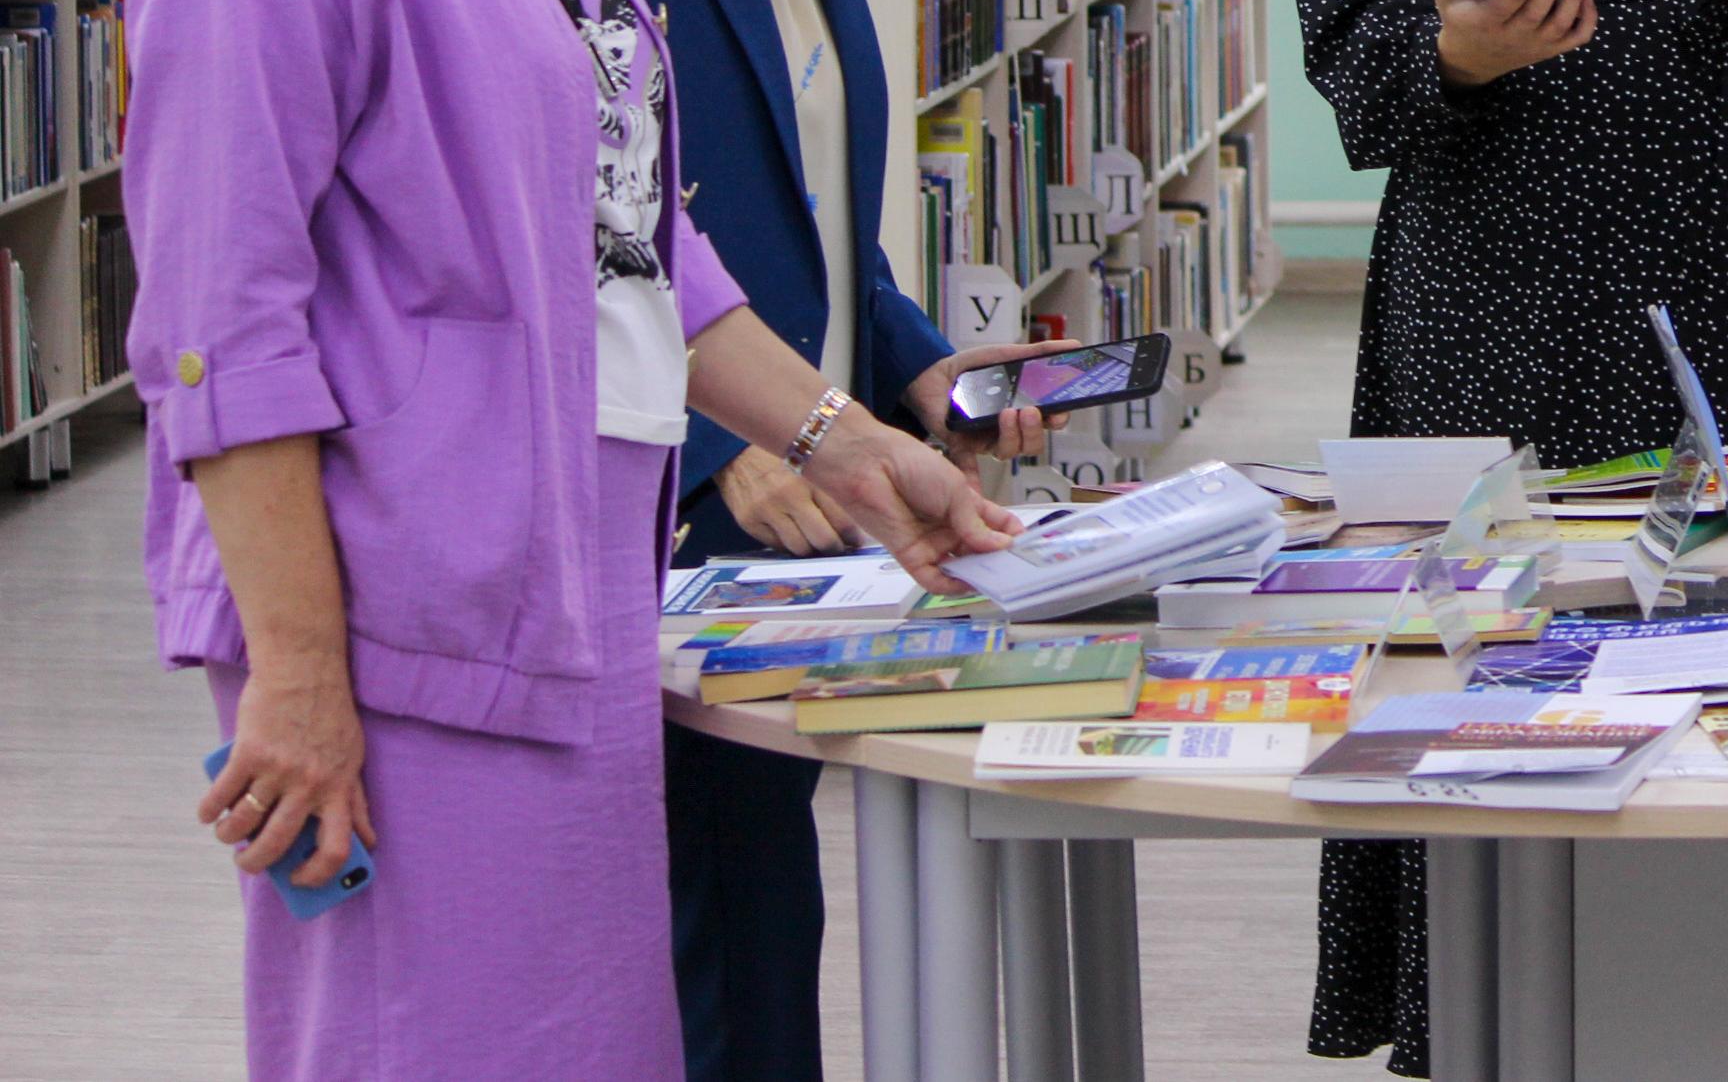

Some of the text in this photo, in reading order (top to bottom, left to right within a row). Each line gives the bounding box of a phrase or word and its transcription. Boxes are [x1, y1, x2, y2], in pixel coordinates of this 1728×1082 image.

[1107, 174, 1134, 216] Л
[1054, 212, 1100, 251] Щ
[970, 295, 1002, 332] У
[1184, 354, 1206, 385] Б
